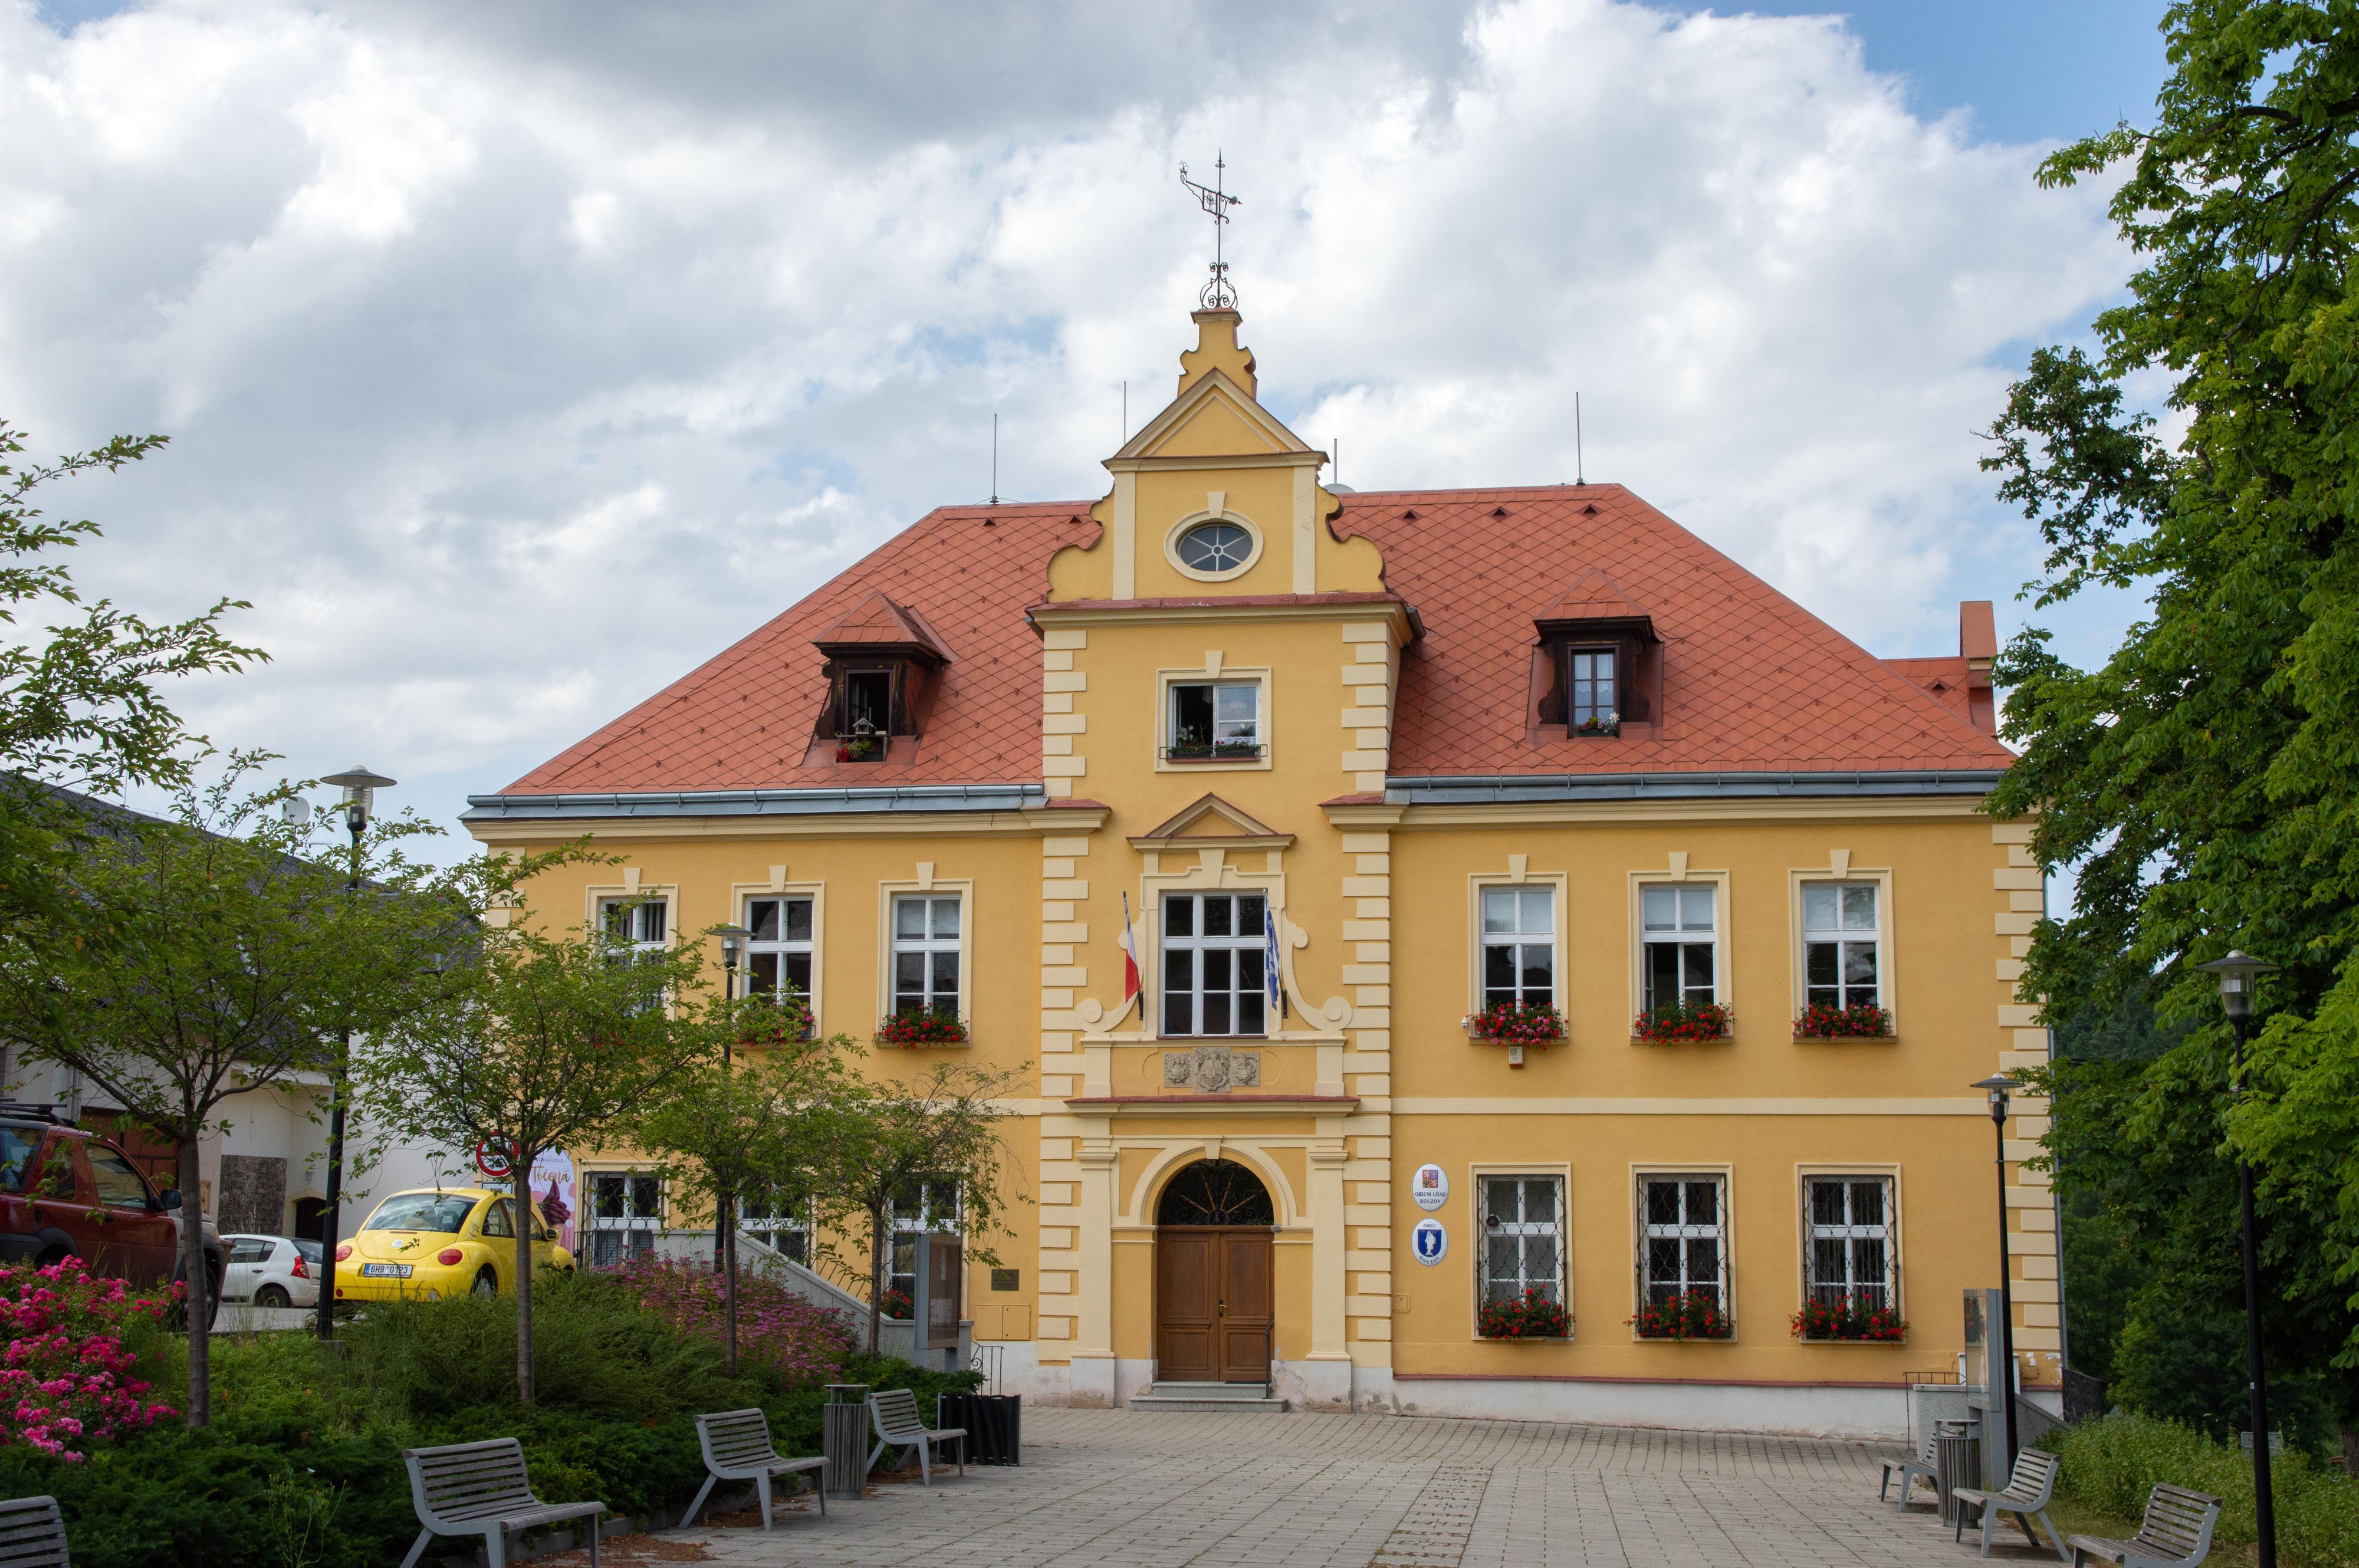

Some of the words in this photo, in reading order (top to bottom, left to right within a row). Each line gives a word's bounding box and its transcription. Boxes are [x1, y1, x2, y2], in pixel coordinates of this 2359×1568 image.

[531, 1165, 570, 1185] Točená
[1419, 1255, 1440, 1264] BOUZOV
[370, 1265, 385, 1273] 6H9
